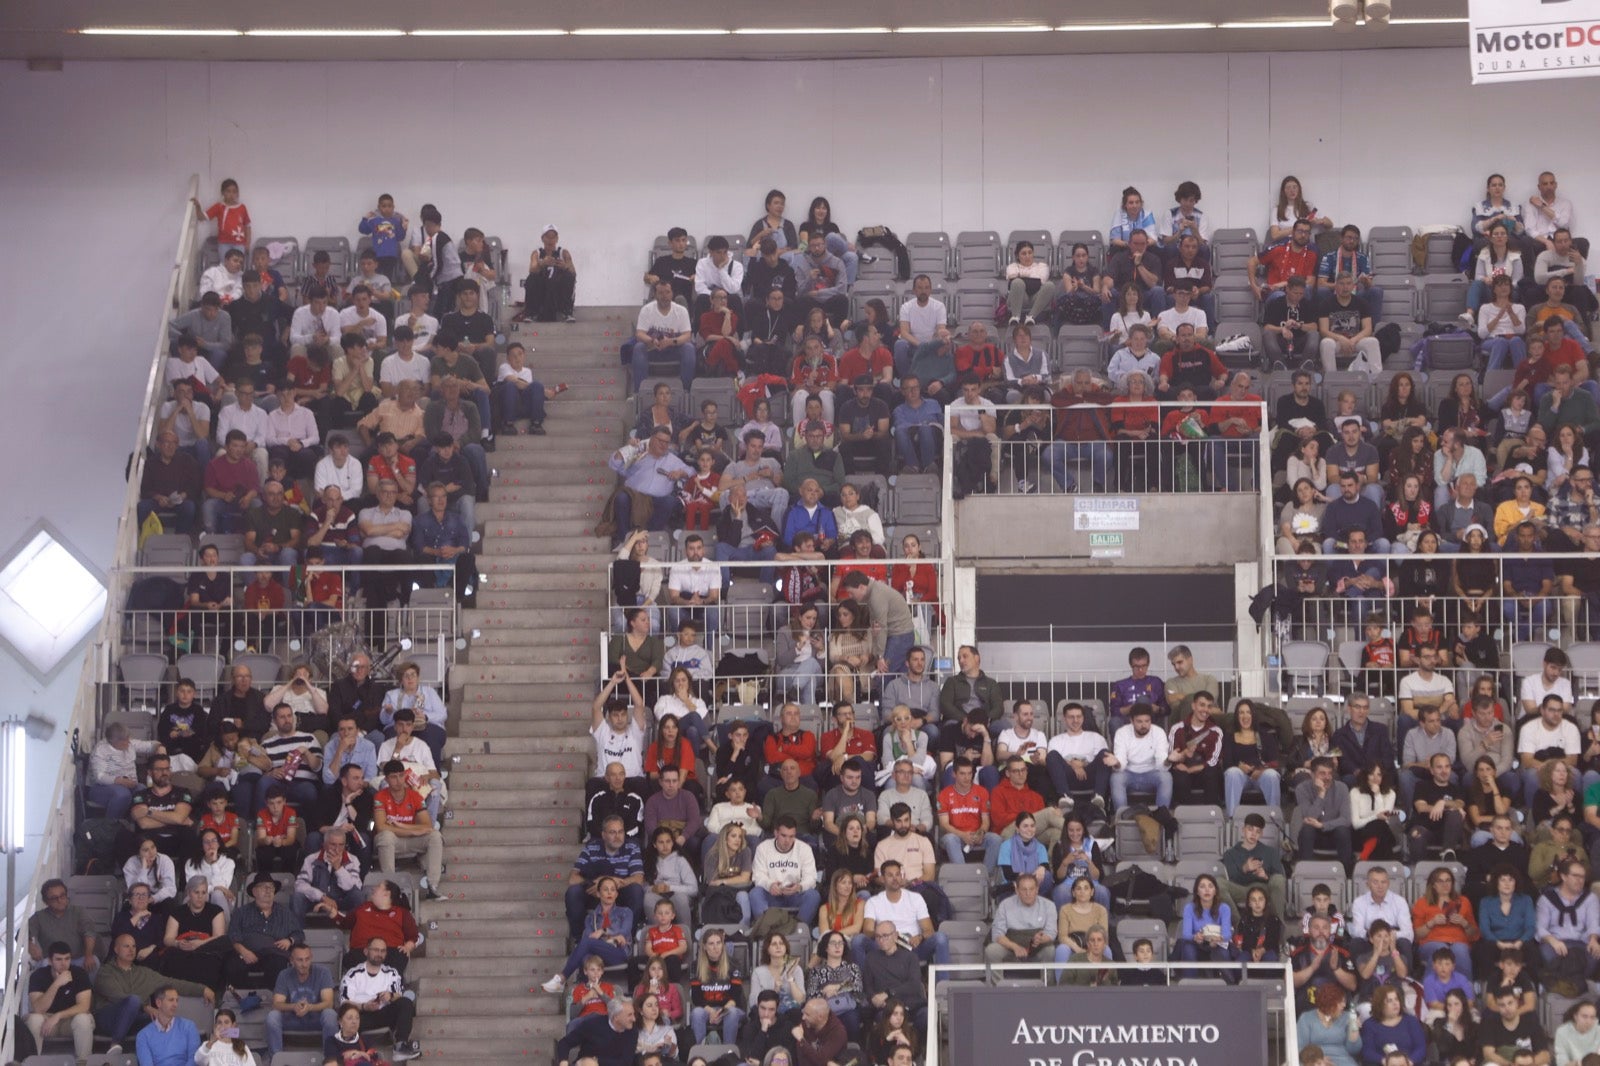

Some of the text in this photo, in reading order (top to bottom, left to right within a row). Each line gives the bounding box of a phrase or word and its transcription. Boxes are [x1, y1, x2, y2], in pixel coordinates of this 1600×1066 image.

[1543, 55, 1600, 68] ESEN
[547, 266, 554, 279] 7
[1091, 534, 1121, 545] SALIDA
[769, 860, 798, 869] adidas
[1011, 1018, 1220, 1045] AYUNTAMIENTO
